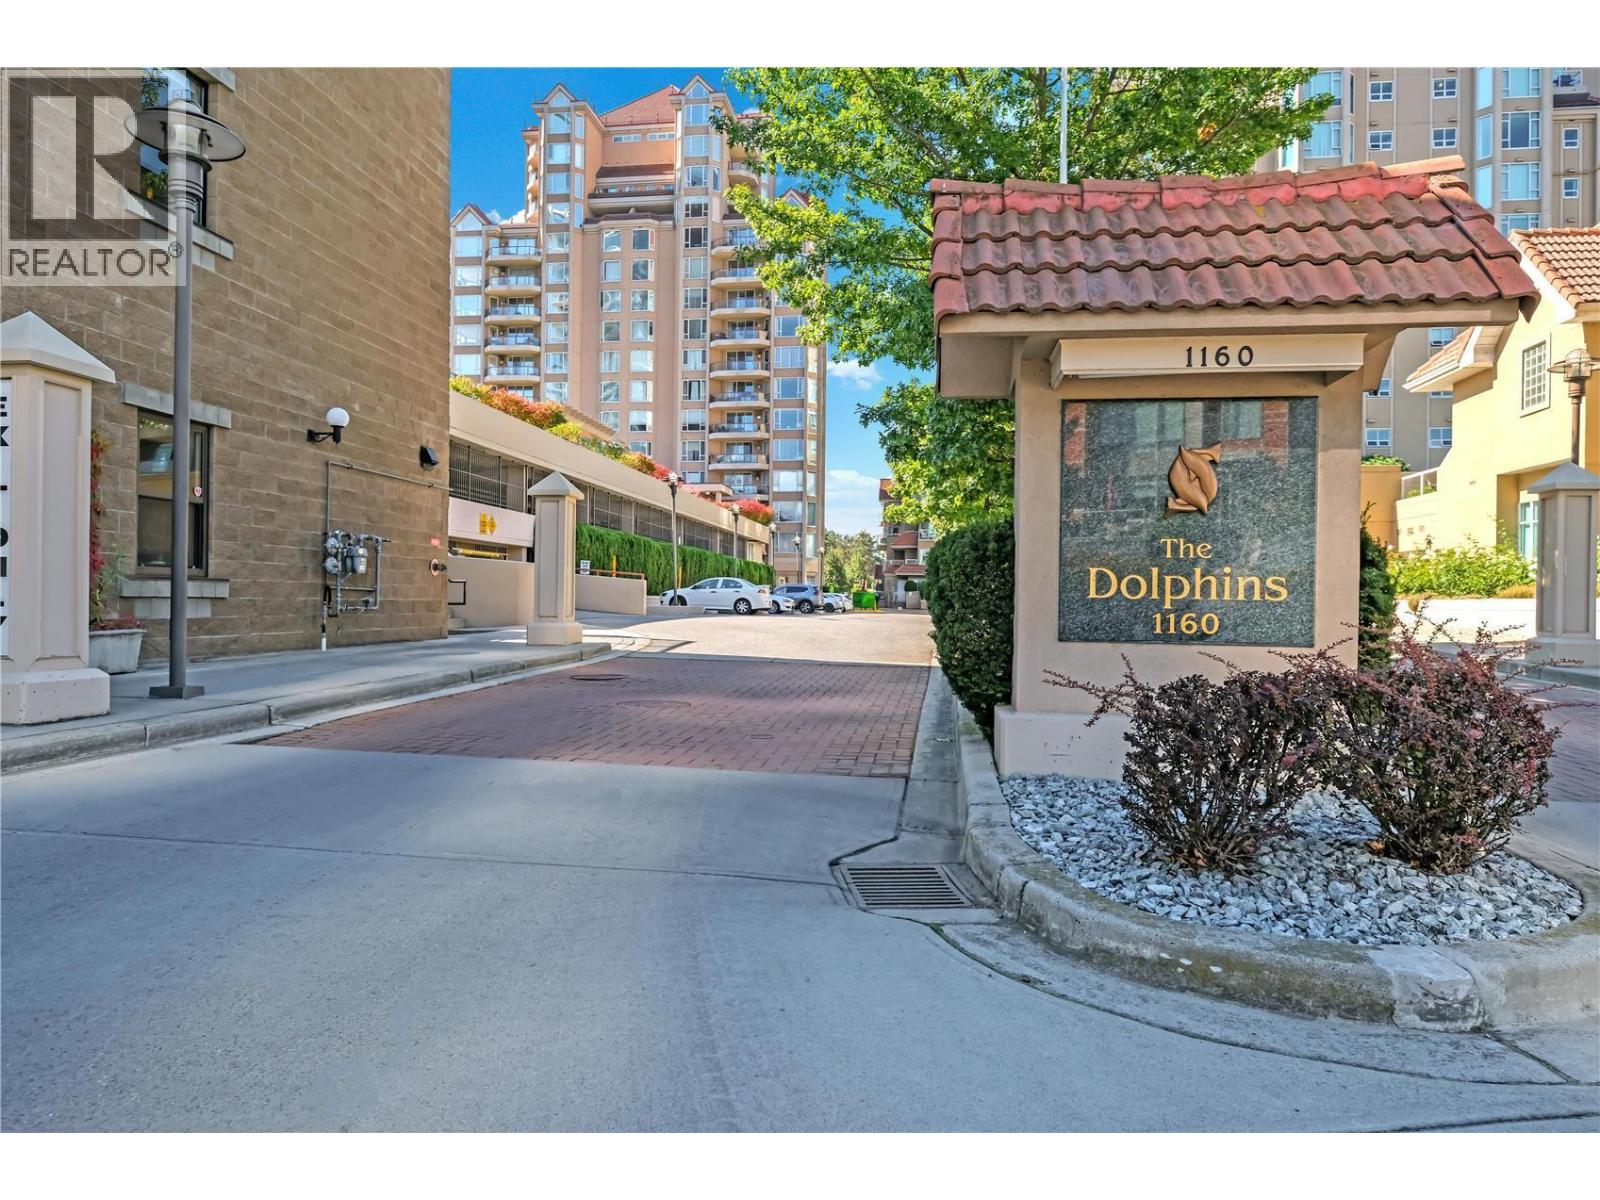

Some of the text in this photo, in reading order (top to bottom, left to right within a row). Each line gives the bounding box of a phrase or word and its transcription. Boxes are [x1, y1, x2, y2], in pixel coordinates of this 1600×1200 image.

[1185, 345, 1254, 368] 1160
[1160, 537, 1214, 559] The
[1087, 566, 1289, 609] Dolphins
[1152, 612, 1220, 635] 1160
